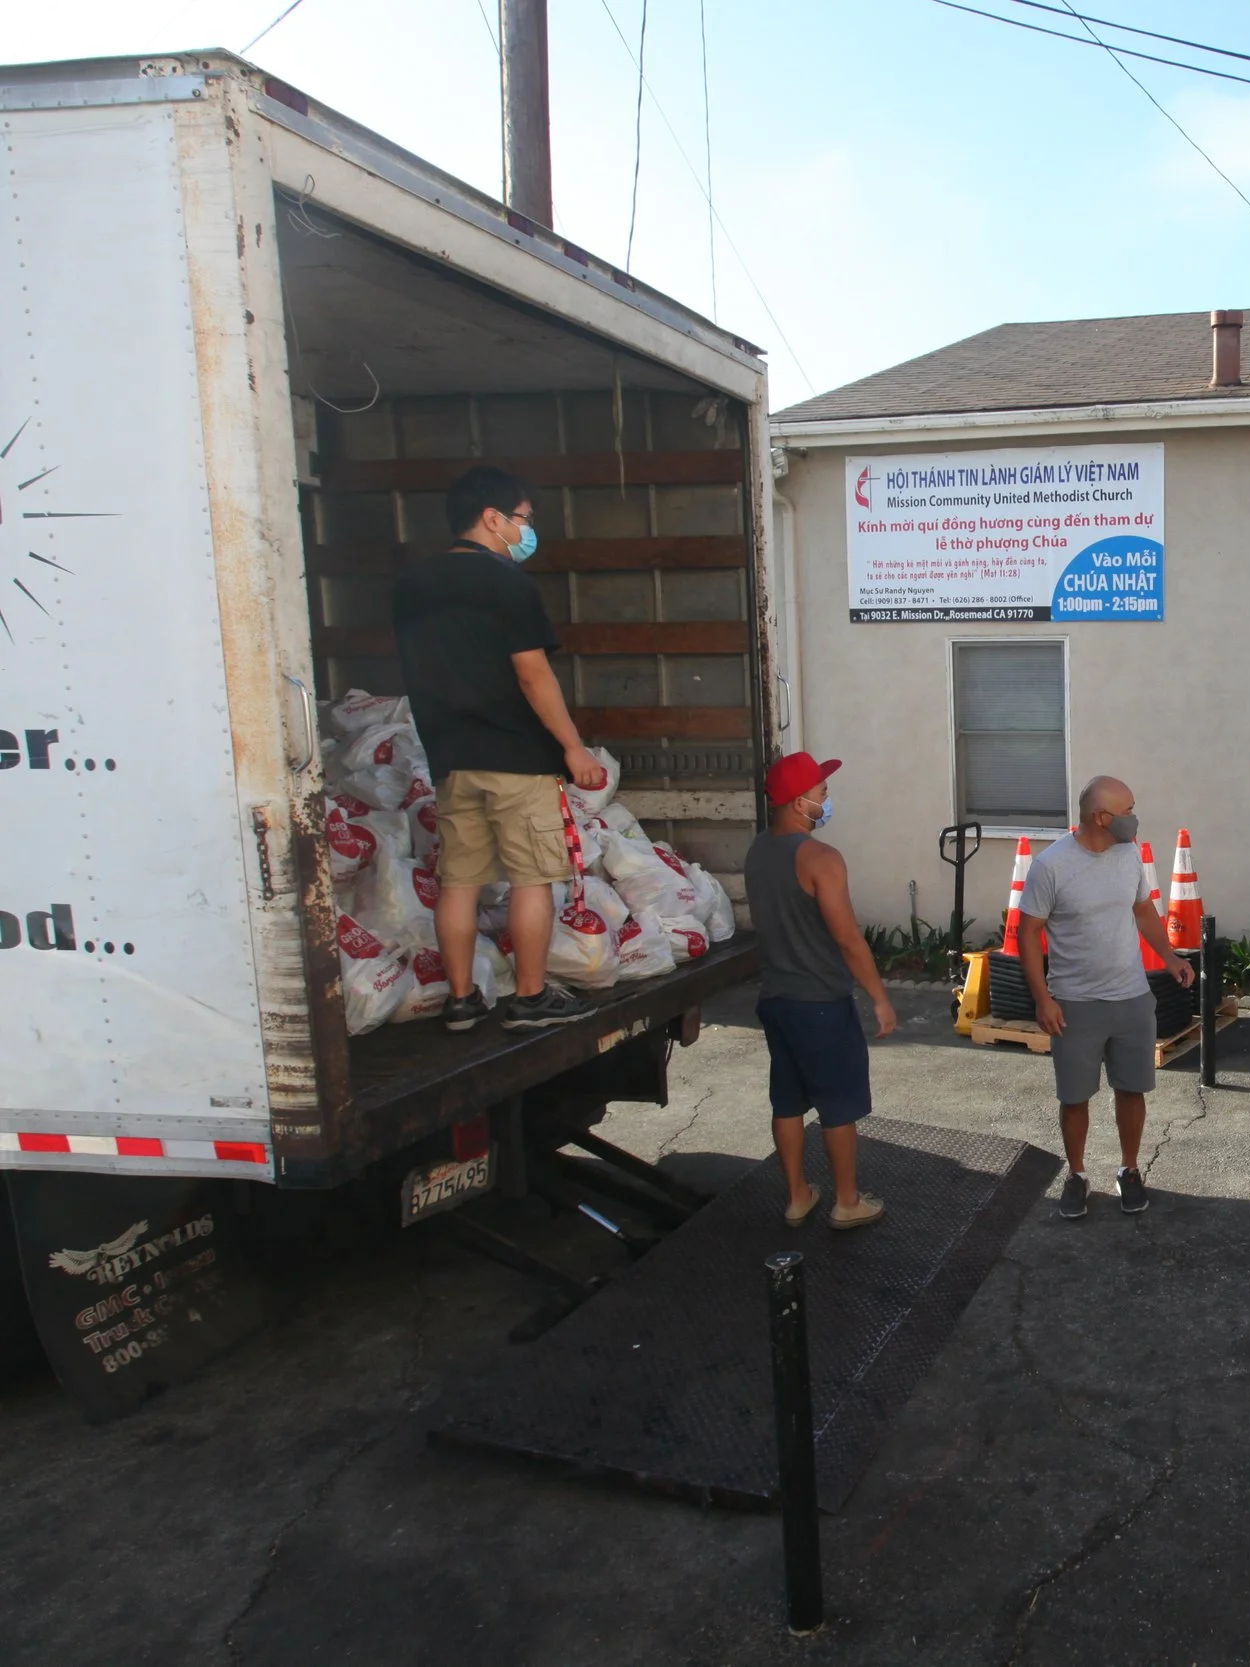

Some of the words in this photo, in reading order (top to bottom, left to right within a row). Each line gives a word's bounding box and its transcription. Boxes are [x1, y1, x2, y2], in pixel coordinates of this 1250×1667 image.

[887, 468, 908, 494] HỘI
[912, 466, 955, 488] THÁNH
[958, 468, 978, 486] TIN
[982, 464, 1016, 486] LÀNH
[1020, 462, 1054, 484] GIÁM
[1058, 460, 1073, 483] LÝ
[1076, 460, 1104, 487] VIỆT
[1108, 462, 1139, 482] NAM
[887, 496, 926, 508] Mission
[929, 494, 990, 508] Community
[994, 492, 1030, 504] United
[1033, 490, 1090, 503] Methodist
[1092, 488, 1133, 502] Church
[858, 520, 886, 533] Kính
[891, 518, 914, 532] mời
[918, 518, 938, 534] quí
[942, 516, 976, 532] đồng
[980, 516, 1023, 532] hương
[1027, 516, 1060, 530] cùng
[1064, 512, 1090, 527] đến
[1094, 514, 1130, 526] tham
[1134, 512, 1154, 528] dự
[936, 536, 947, 550] lễ
[951, 538, 973, 550] thờ
[977, 538, 1028, 552] phượng
[1033, 535, 1068, 548] Chúa
[1092, 552, 1122, 567] Vào
[1126, 549, 1156, 566] Mỗi
[884, 572, 895, 580] cho
[1064, 570, 1108, 592] CHÚA
[1113, 570, 1157, 596] NHẬT
[870, 611, 890, 620] 9032
[893, 611, 900, 620] E.
[901, 610, 932, 620] Mission
[950, 609, 992, 619] Rosemead
[994, 610, 1005, 619] CA
[1007, 609, 1033, 618] 91770
[1058, 597, 1102, 612] 1:00pm
[1112, 596, 1157, 612] 2:15pm
[86, 1213, 214, 1286] REYNOLDS
[74, 1284, 140, 1330] GMC
[82, 1308, 156, 1354] Truck
